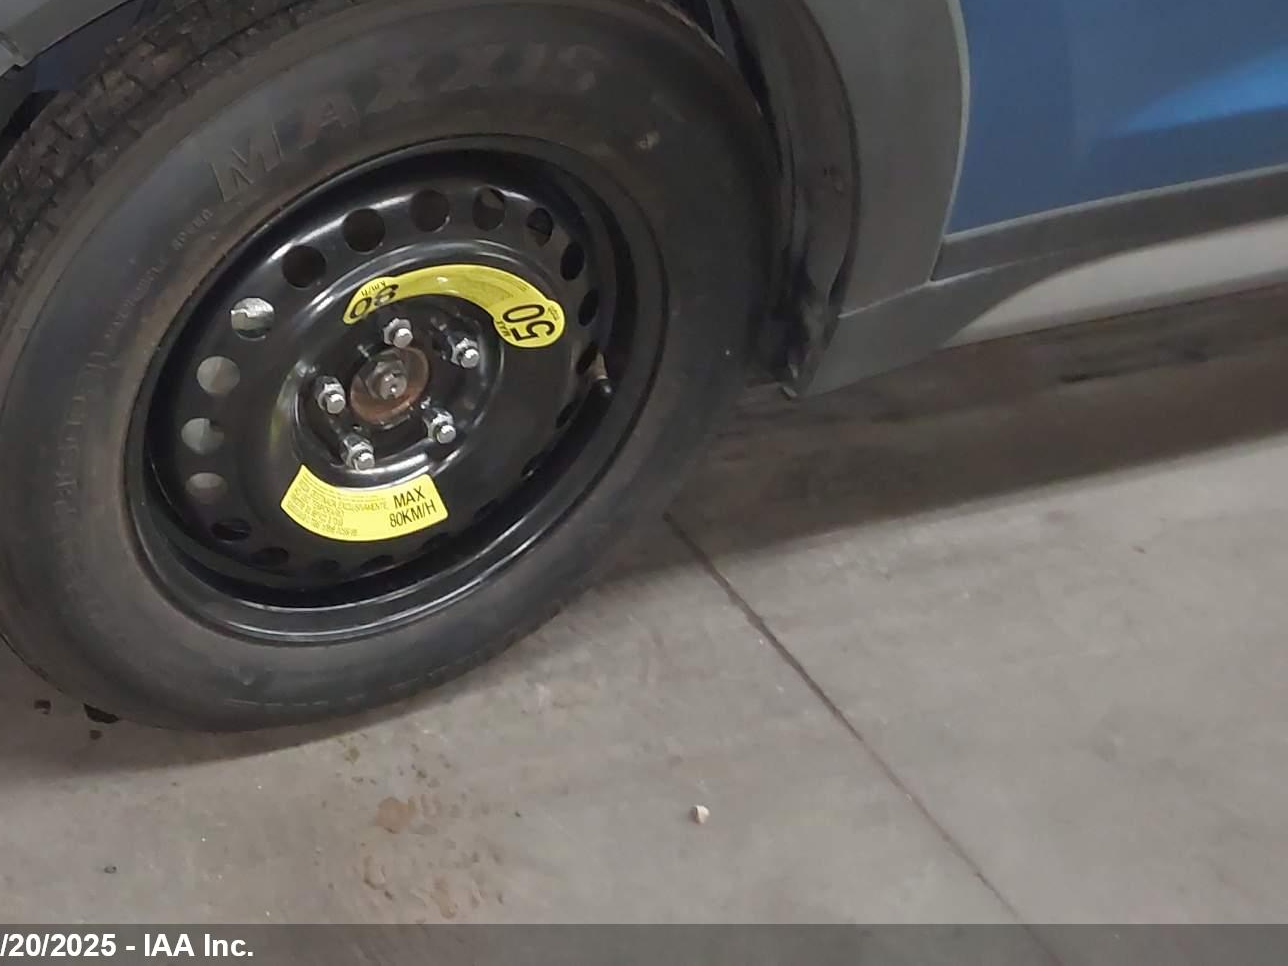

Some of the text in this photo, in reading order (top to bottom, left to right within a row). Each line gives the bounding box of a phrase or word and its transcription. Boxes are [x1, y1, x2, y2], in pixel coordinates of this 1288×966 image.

[502, 304, 555, 342] 50
[392, 485, 427, 509] MAX
[389, 499, 438, 528] 80KM/H
